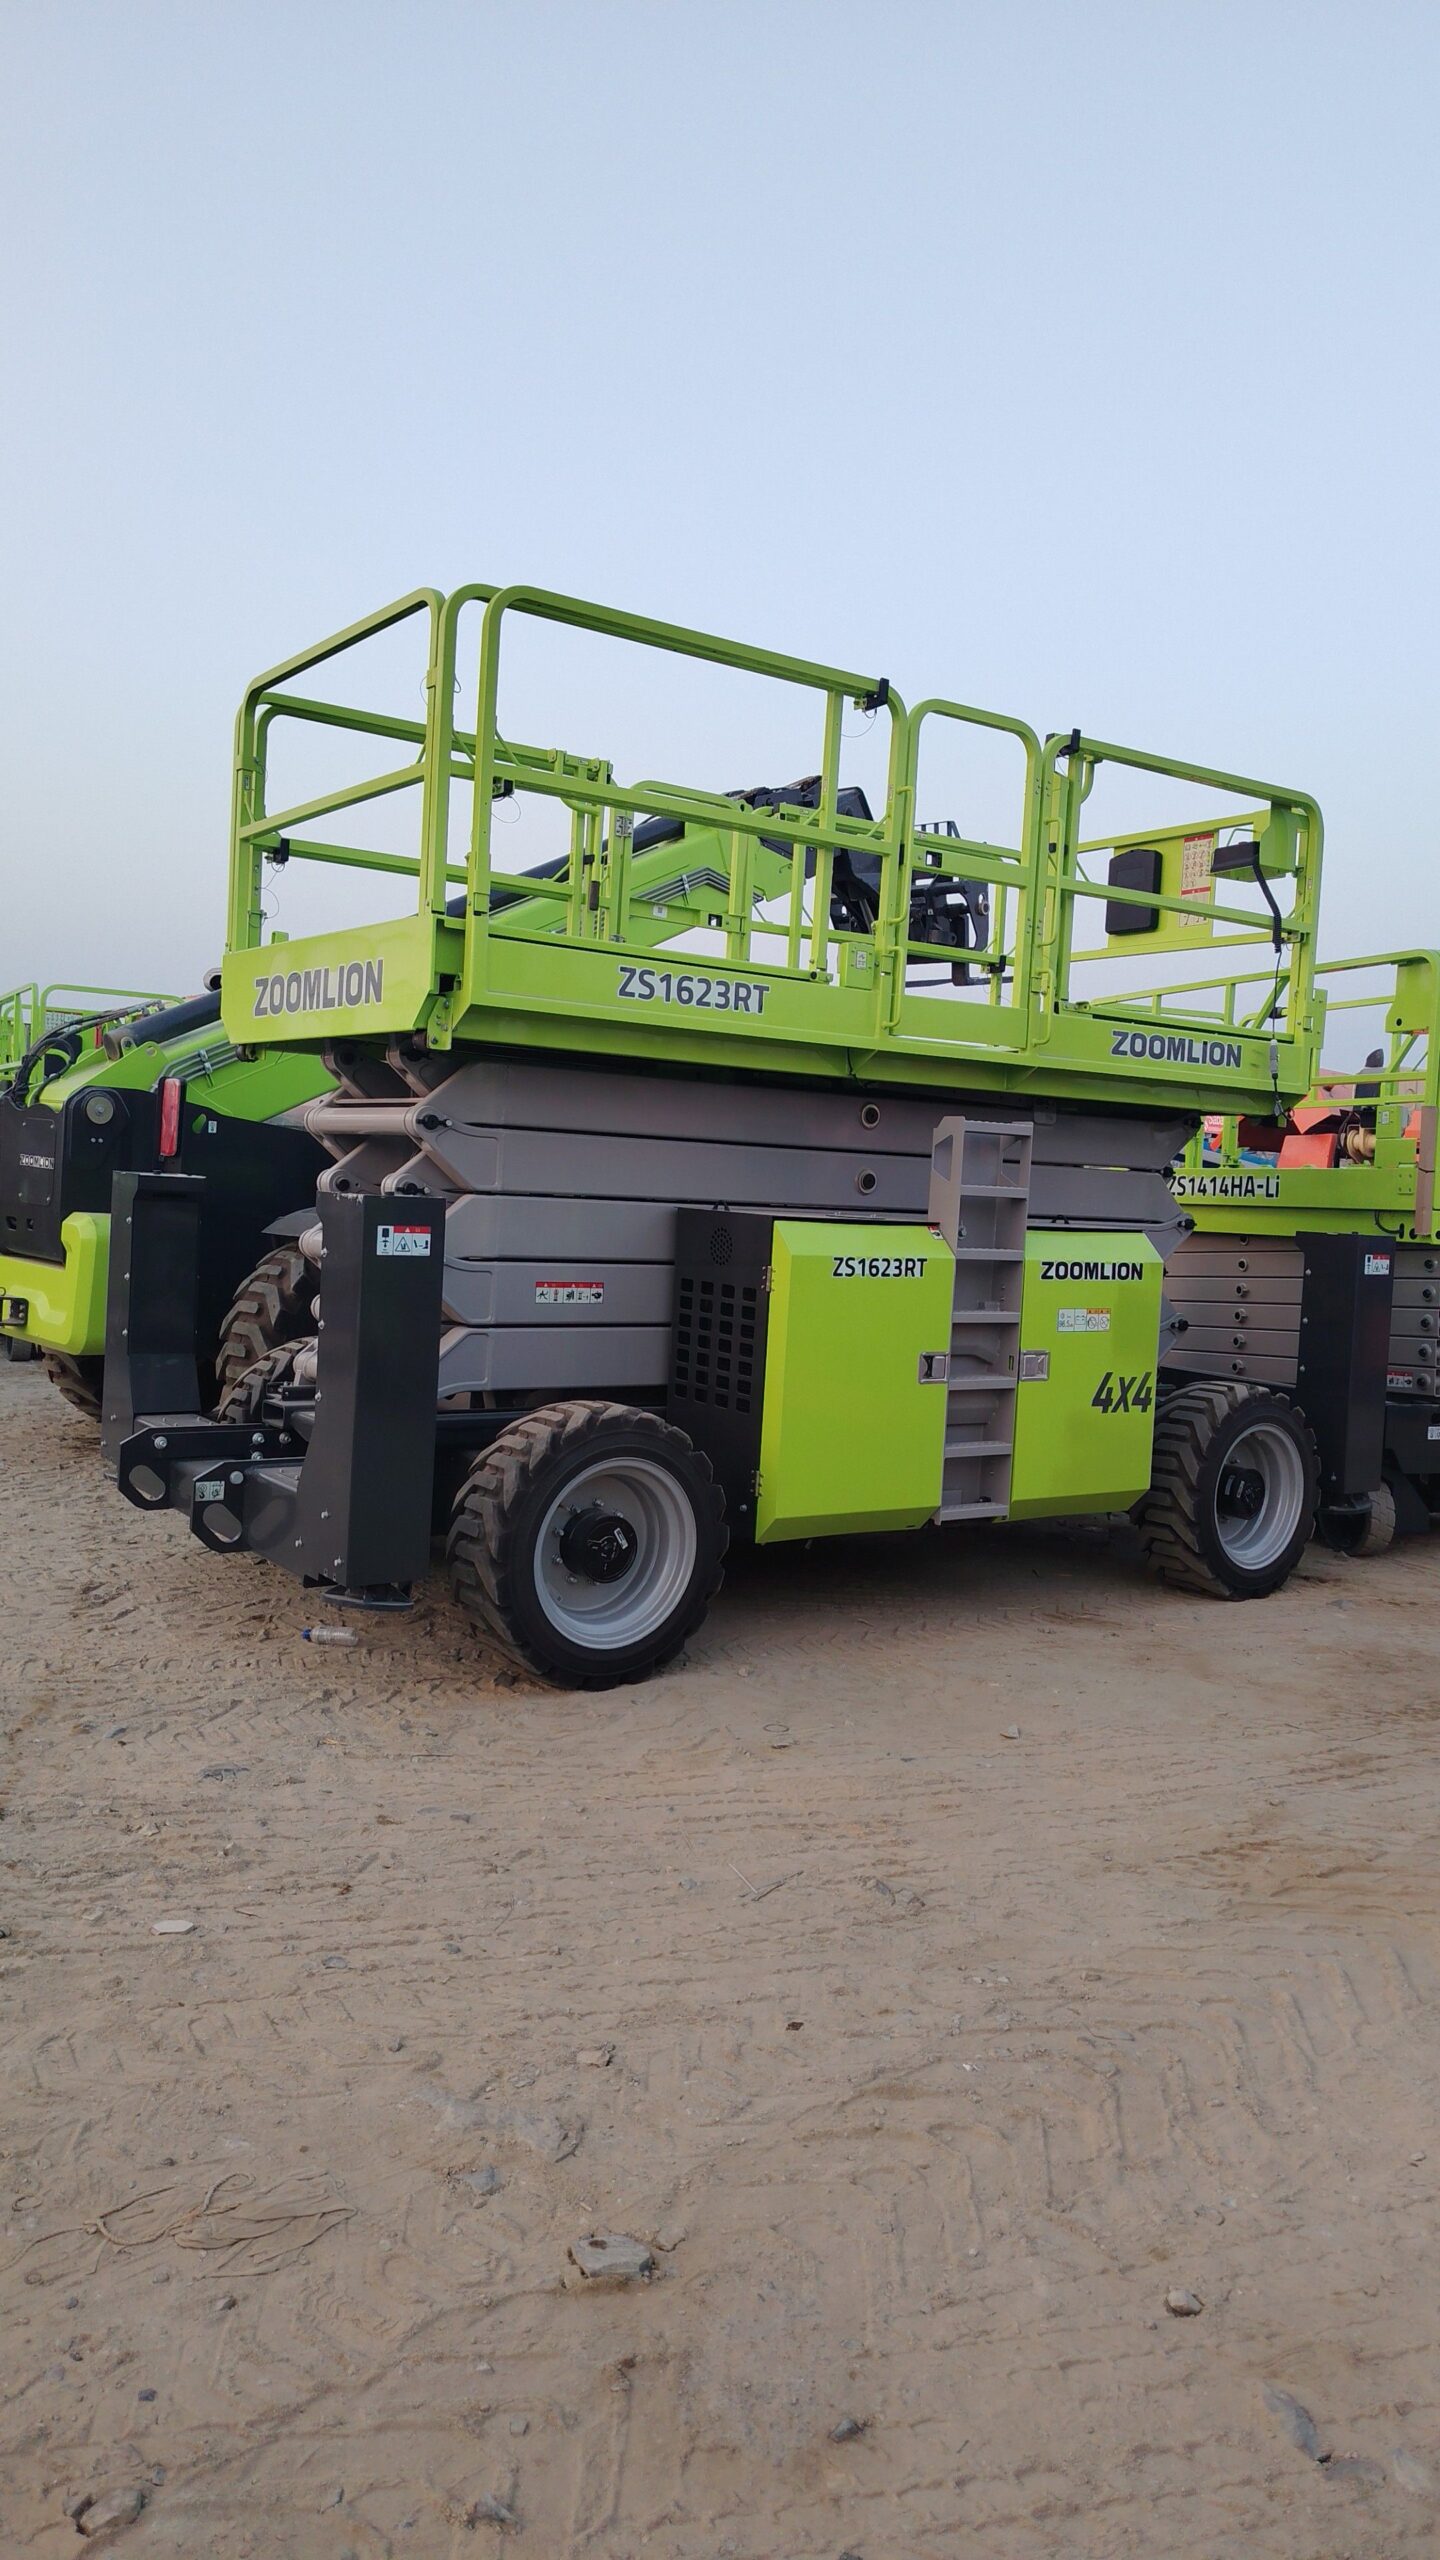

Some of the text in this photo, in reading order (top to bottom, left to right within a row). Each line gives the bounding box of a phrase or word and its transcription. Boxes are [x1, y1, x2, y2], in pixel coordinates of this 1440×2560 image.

[254, 959, 384, 1017] ZOOMLION
[618, 966, 770, 1014] ZS1623RT
[1111, 1030, 1242, 1068] ZOOMLION
[20, 1153, 55, 1170] ZOOMLION
[832, 1256, 928, 1278] ZS1623RT
[1040, 1261, 1144, 1281] ZOOMLION
